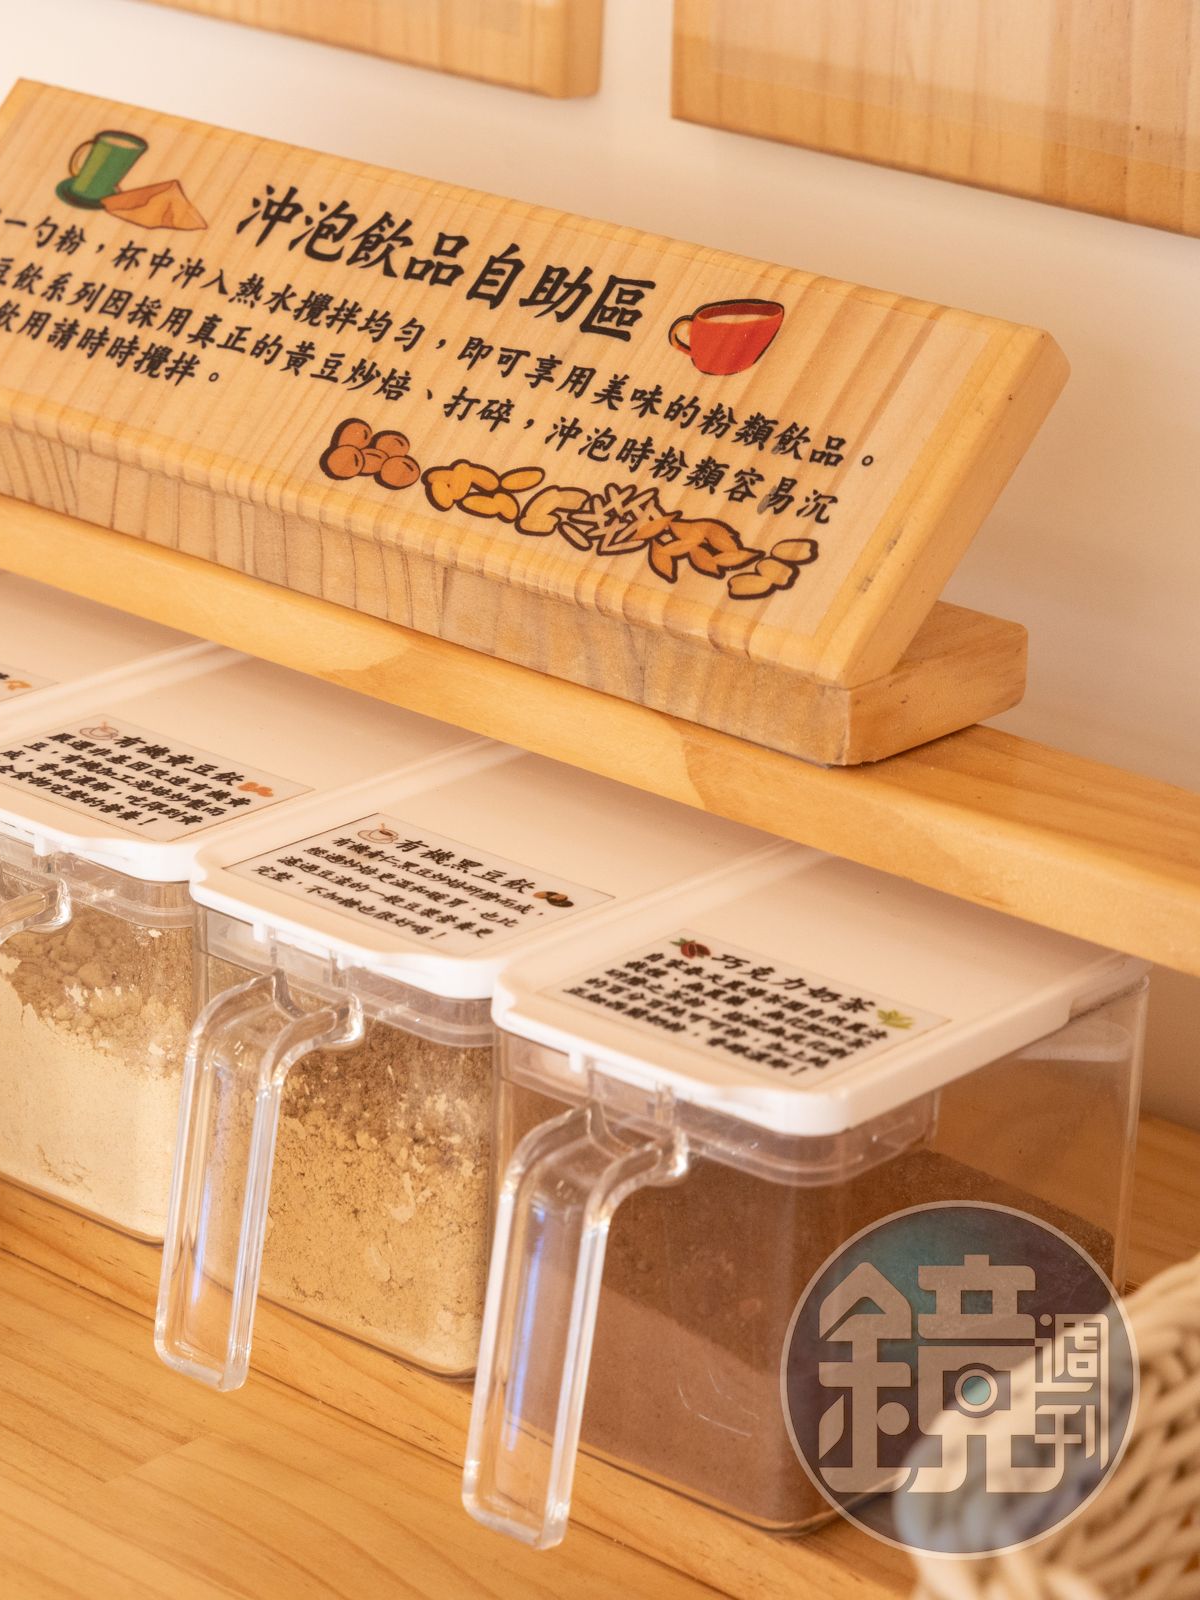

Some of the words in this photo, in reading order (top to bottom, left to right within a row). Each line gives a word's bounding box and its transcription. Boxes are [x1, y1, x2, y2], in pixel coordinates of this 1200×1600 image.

[236, 184, 657, 342] 沖泡飲品自助區
[113, 735, 244, 786] 有機黃豆飲
[394, 839, 535, 894] 有機黑豆飲
[711, 953, 875, 1013] 巧克力奶茶
